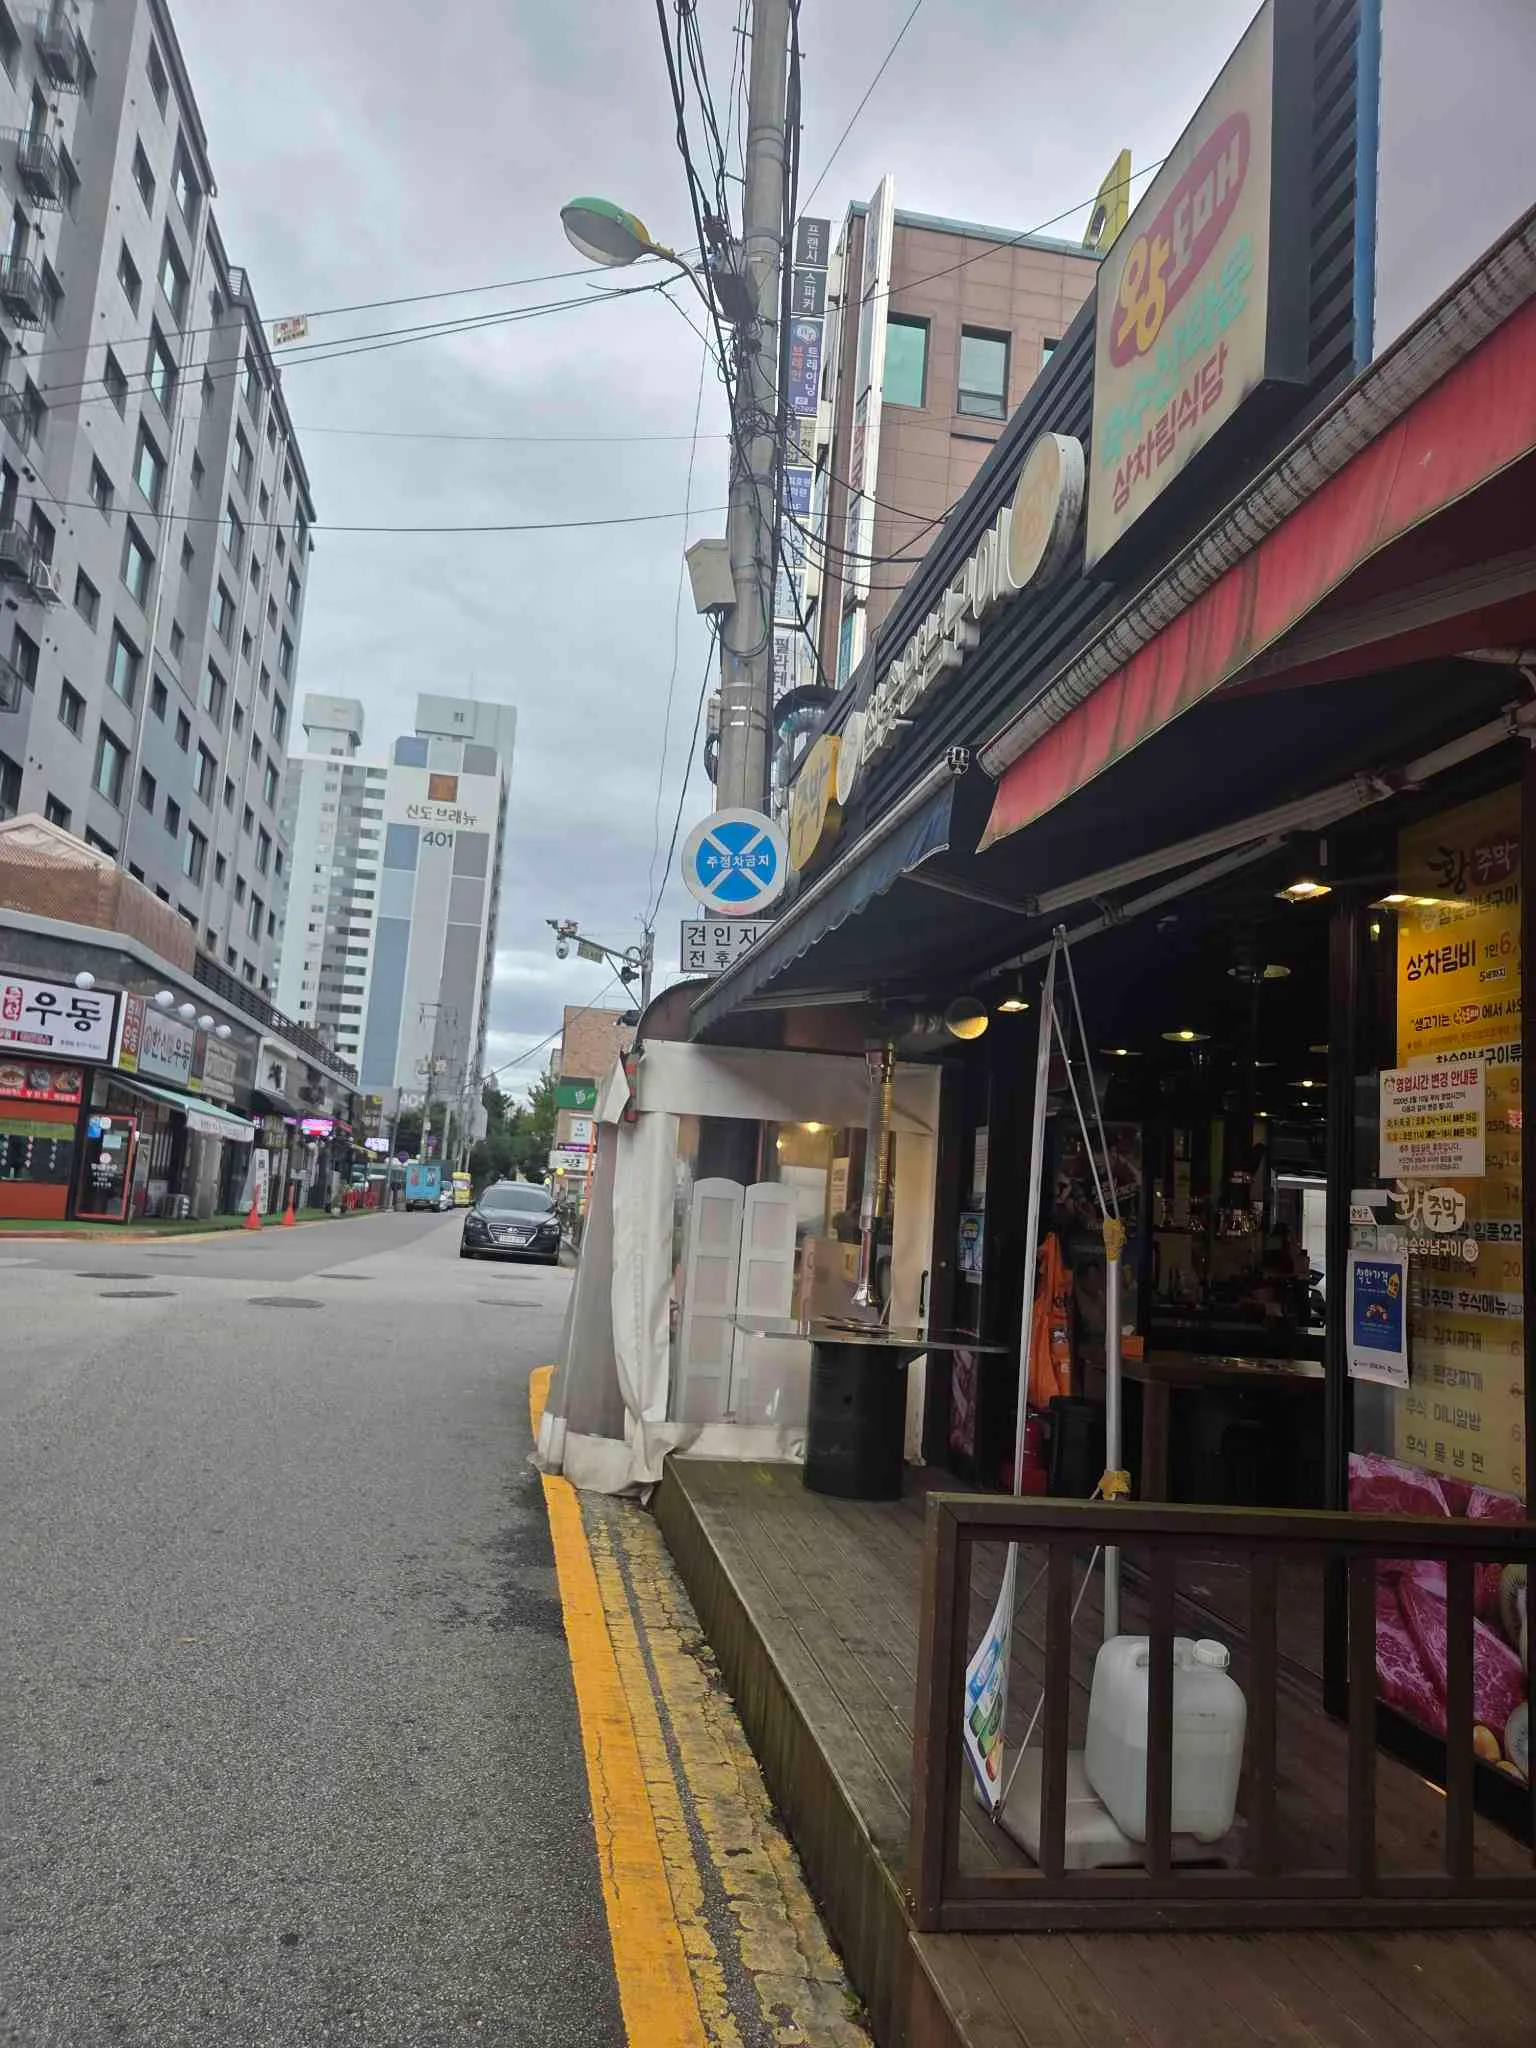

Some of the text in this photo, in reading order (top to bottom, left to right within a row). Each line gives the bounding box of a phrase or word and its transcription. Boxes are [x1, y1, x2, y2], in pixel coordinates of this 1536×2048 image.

[1112, 341, 1229, 515] 상차림식당
[423, 831, 454, 849] 401
[706, 853, 769, 870] 주정차금지
[1406, 939, 1477, 982] 상차림비
[25, 991, 101, 1032] 우동
[1396, 1068, 1478, 1093] 영업시간 변경 안내문
[1434, 1326, 1483, 1353] 김치찌개
[1406, 1398, 1427, 1419] 후식
[1433, 1403, 1482, 1432] 미니알밥
[1406, 1436, 1427, 1457] 후식
